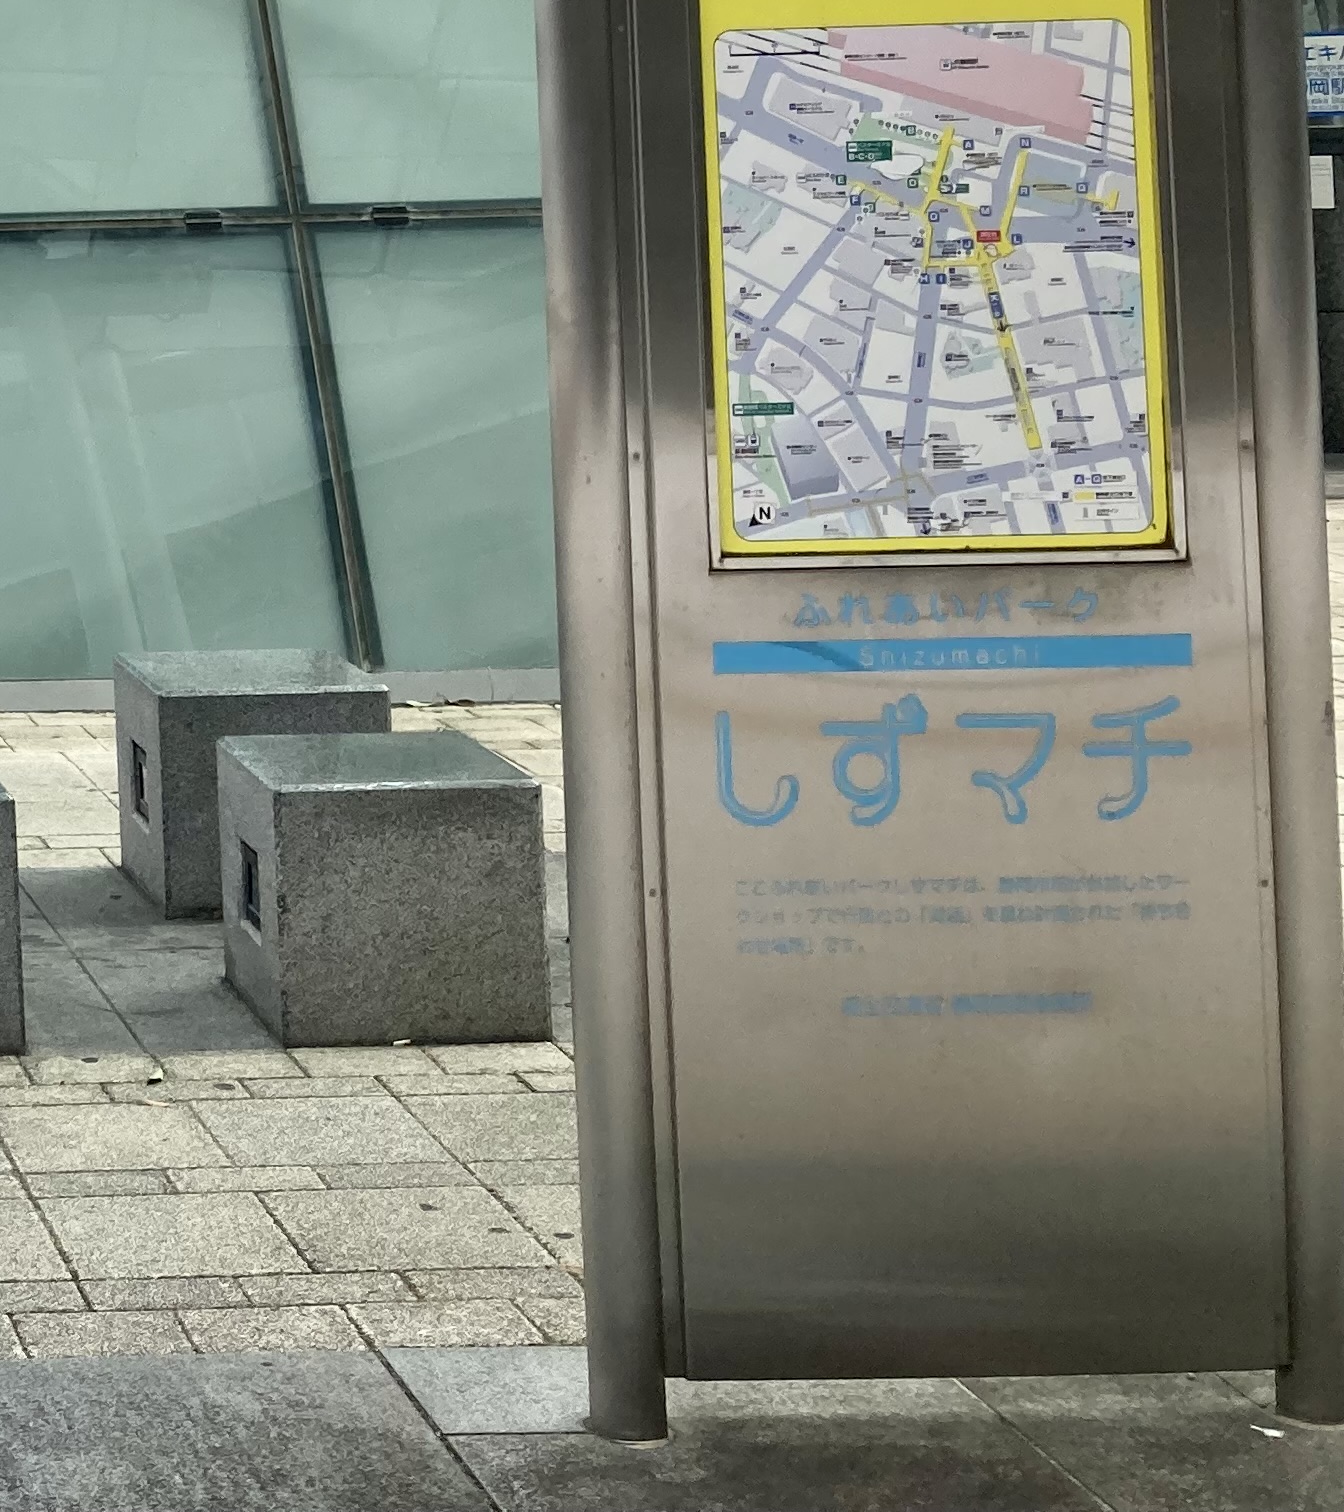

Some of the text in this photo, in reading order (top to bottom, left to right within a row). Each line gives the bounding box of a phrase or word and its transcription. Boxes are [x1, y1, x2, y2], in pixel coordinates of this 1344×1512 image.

[758, 506, 771, 520] N
[716, 693, 1193, 828] しずマチ
